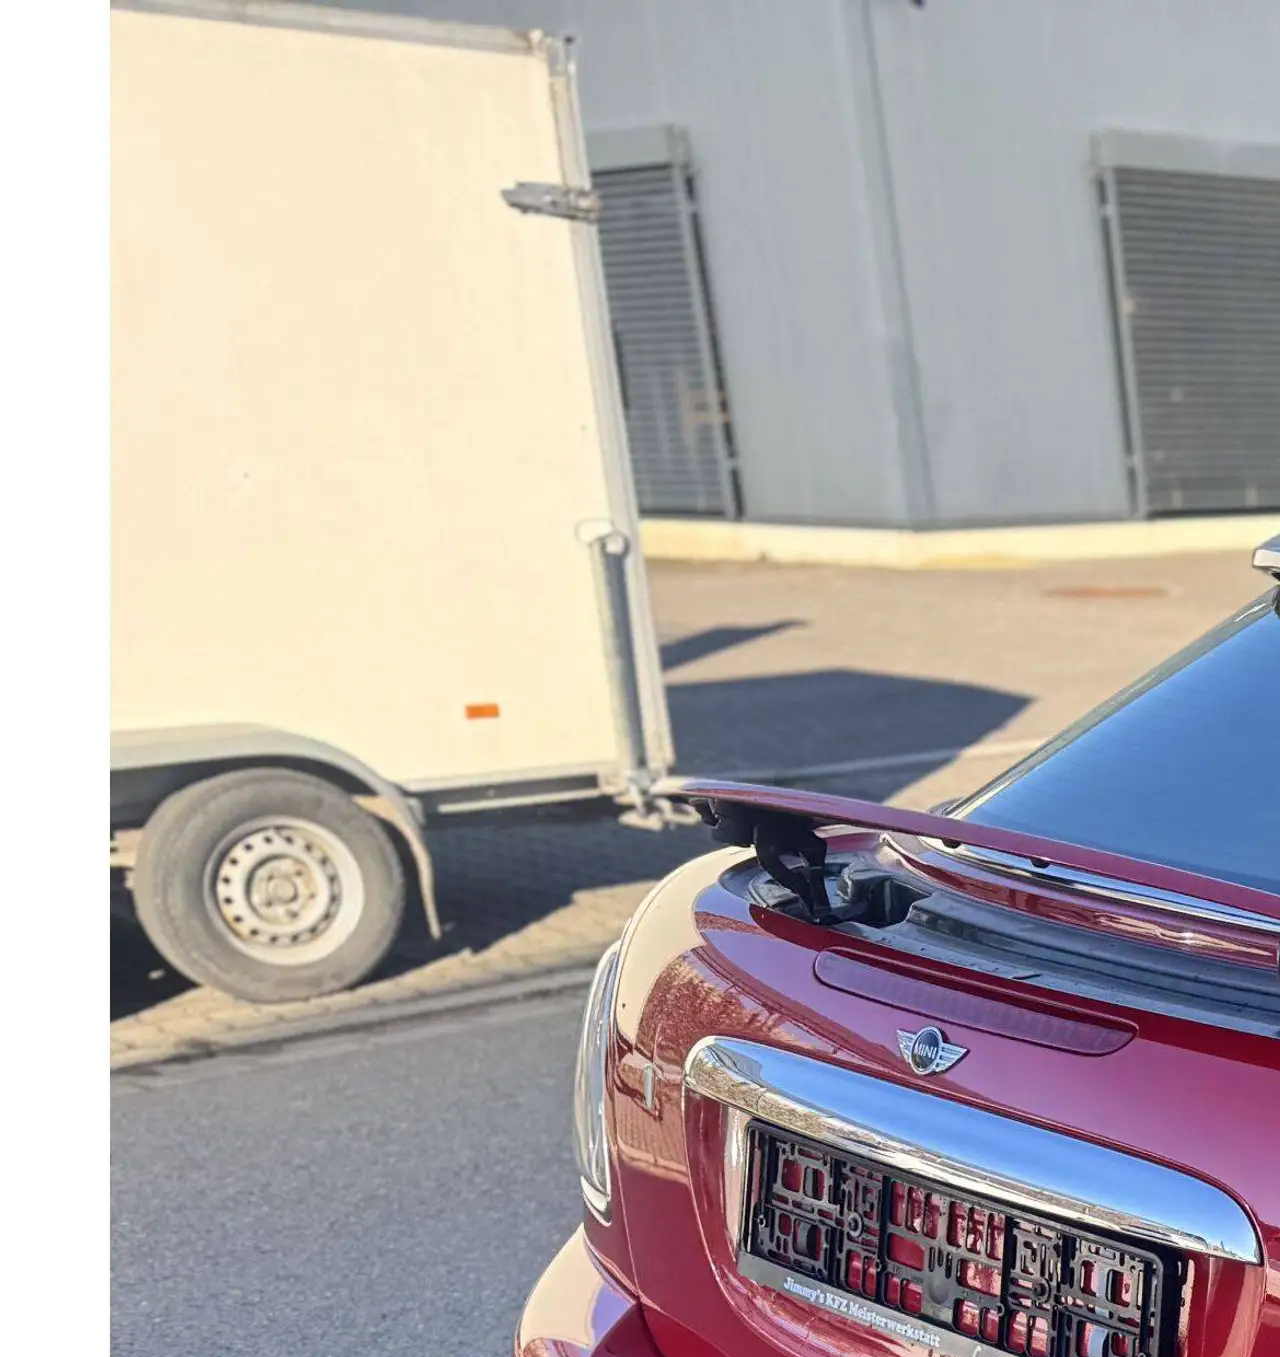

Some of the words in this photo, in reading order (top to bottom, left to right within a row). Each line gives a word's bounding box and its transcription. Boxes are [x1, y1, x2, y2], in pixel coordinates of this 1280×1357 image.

[913, 1042, 937, 1060] MINI
[783, 1276, 825, 1303] Jimmy's
[825, 1292, 848, 1312] KFZ
[849, 1301, 941, 1347] Meisterwerkstatt
